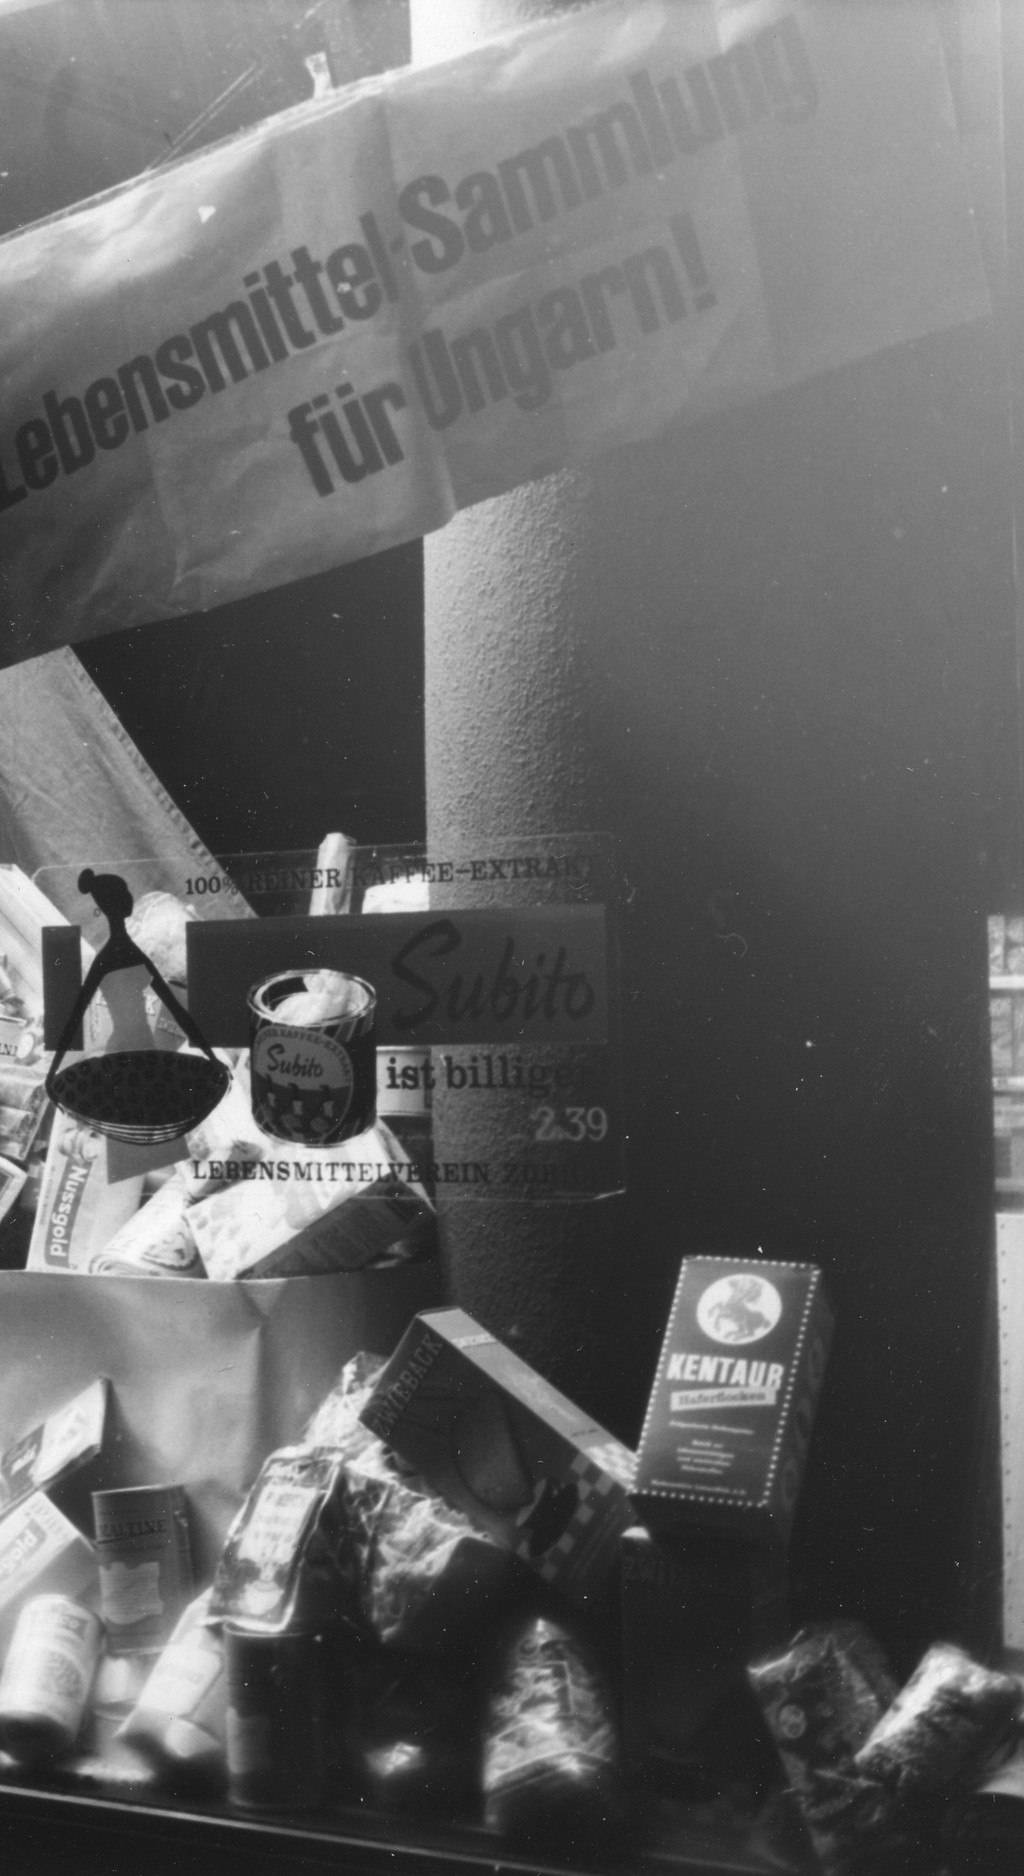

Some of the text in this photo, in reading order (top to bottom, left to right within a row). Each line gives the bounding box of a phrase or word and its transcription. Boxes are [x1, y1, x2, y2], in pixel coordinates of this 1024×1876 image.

[288, 212, 717, 498] für Ungarn!
[185, 875, 239, 895] 100%
[247, 868, 342, 891] REINER
[391, 918, 596, 1030] Subito
[267, 1043, 324, 1078] Subito
[387, 1056, 436, 1089] ist
[192, 1159, 491, 1184] LEBENSMITTELVEREIN
[49, 1164, 89, 1258] Nussgold
[666, 1352, 785, 1391] KENTAUR
